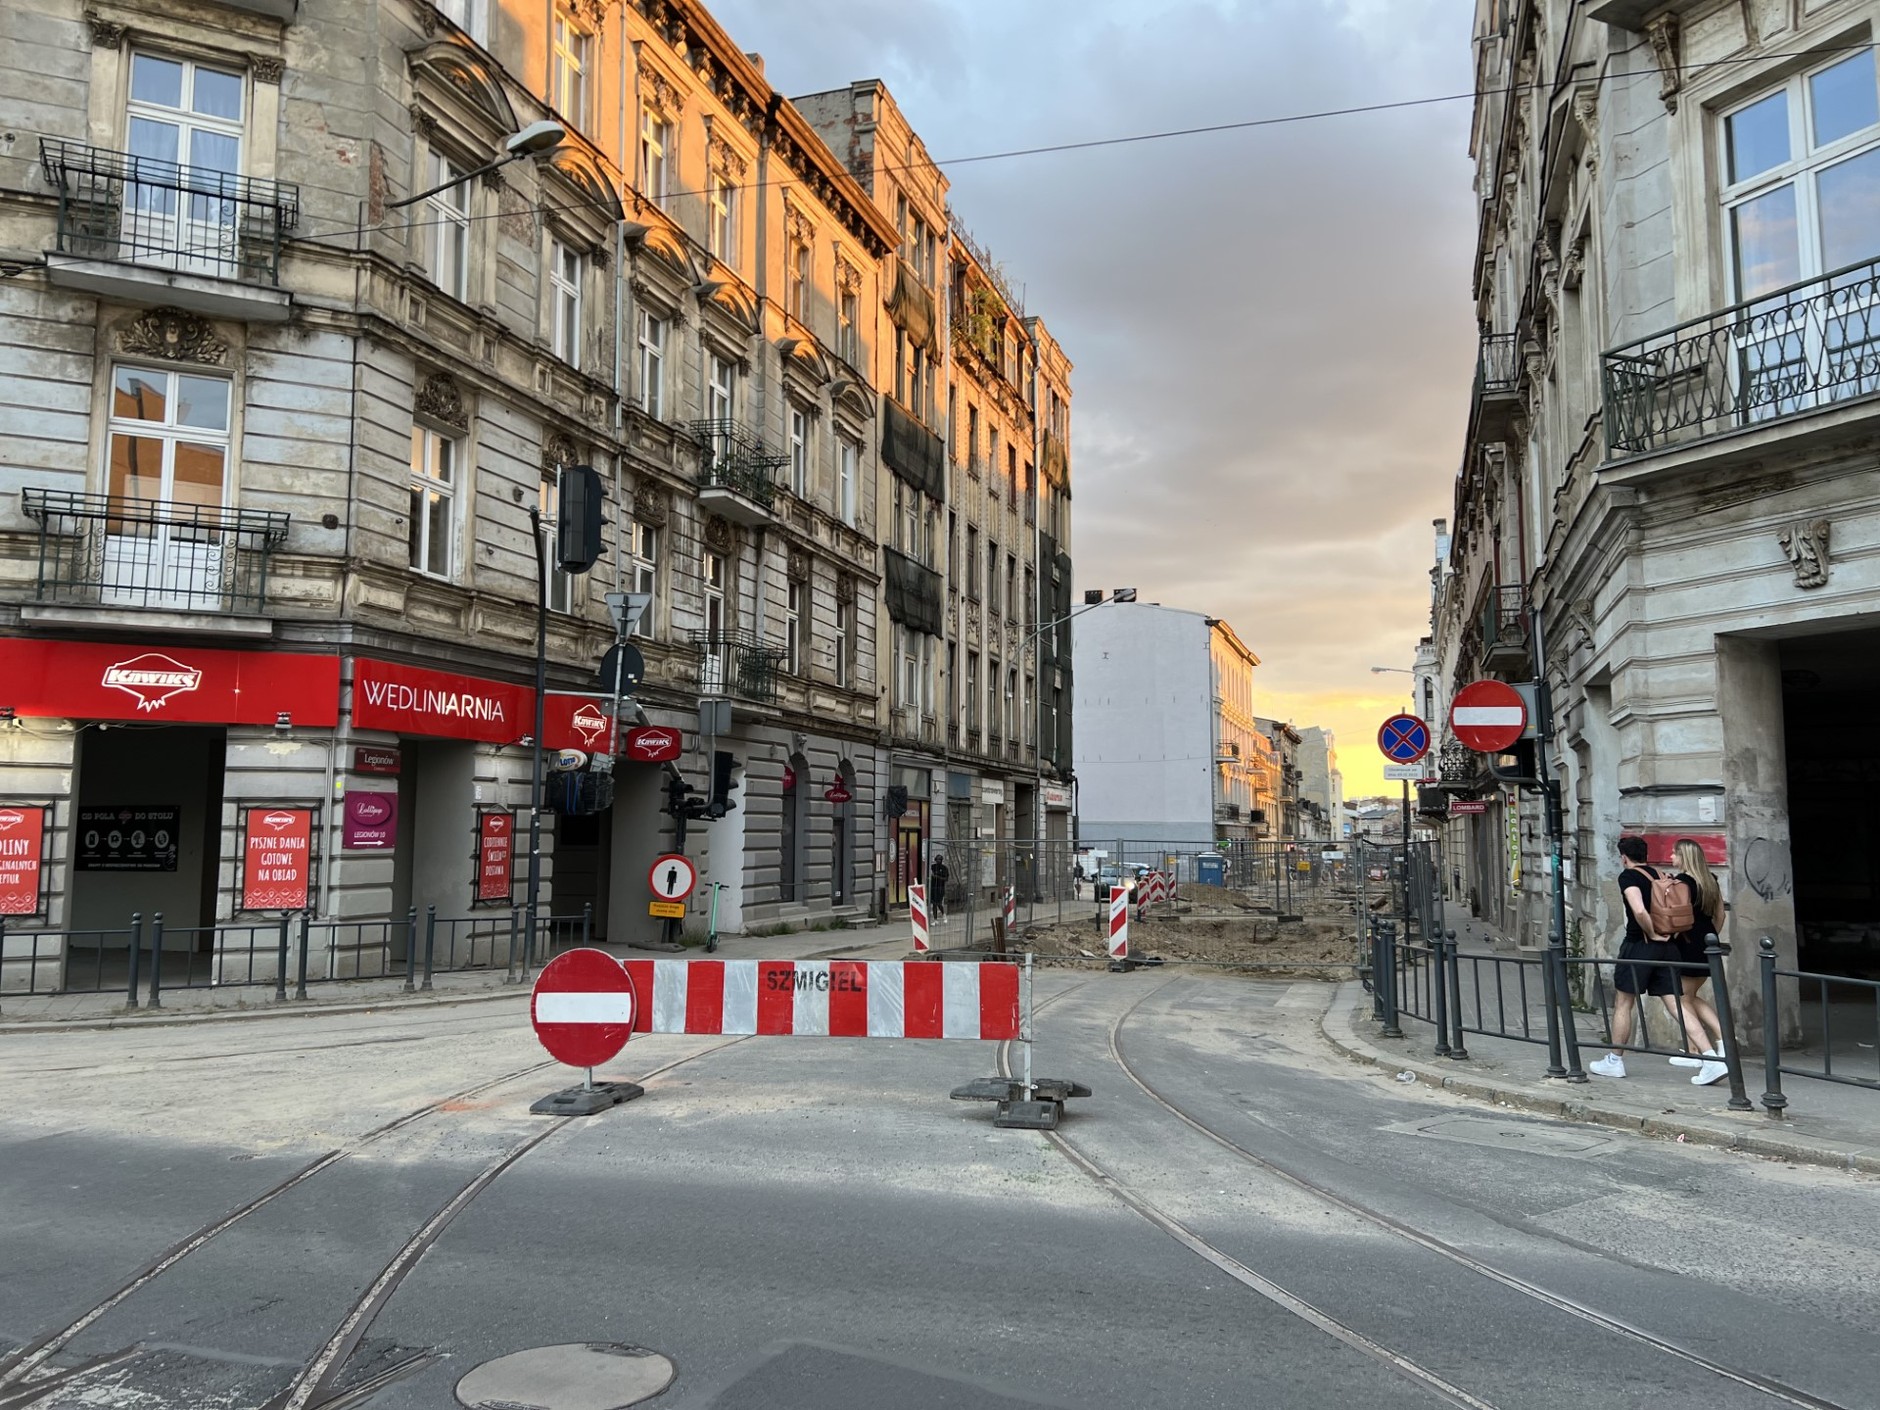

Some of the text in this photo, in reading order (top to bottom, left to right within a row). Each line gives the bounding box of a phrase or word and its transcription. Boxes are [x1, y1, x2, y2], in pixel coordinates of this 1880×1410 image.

[363, 680, 504, 722] WĘDLINIARNIA
[364, 753, 394, 766] Legionów
[250, 837, 305, 849] PYSZNE DANIA
[261, 853, 293, 865] GOTOWE
[258, 869, 297, 881] NA OBIAD
[767, 970, 862, 992] SZMIGIEL
